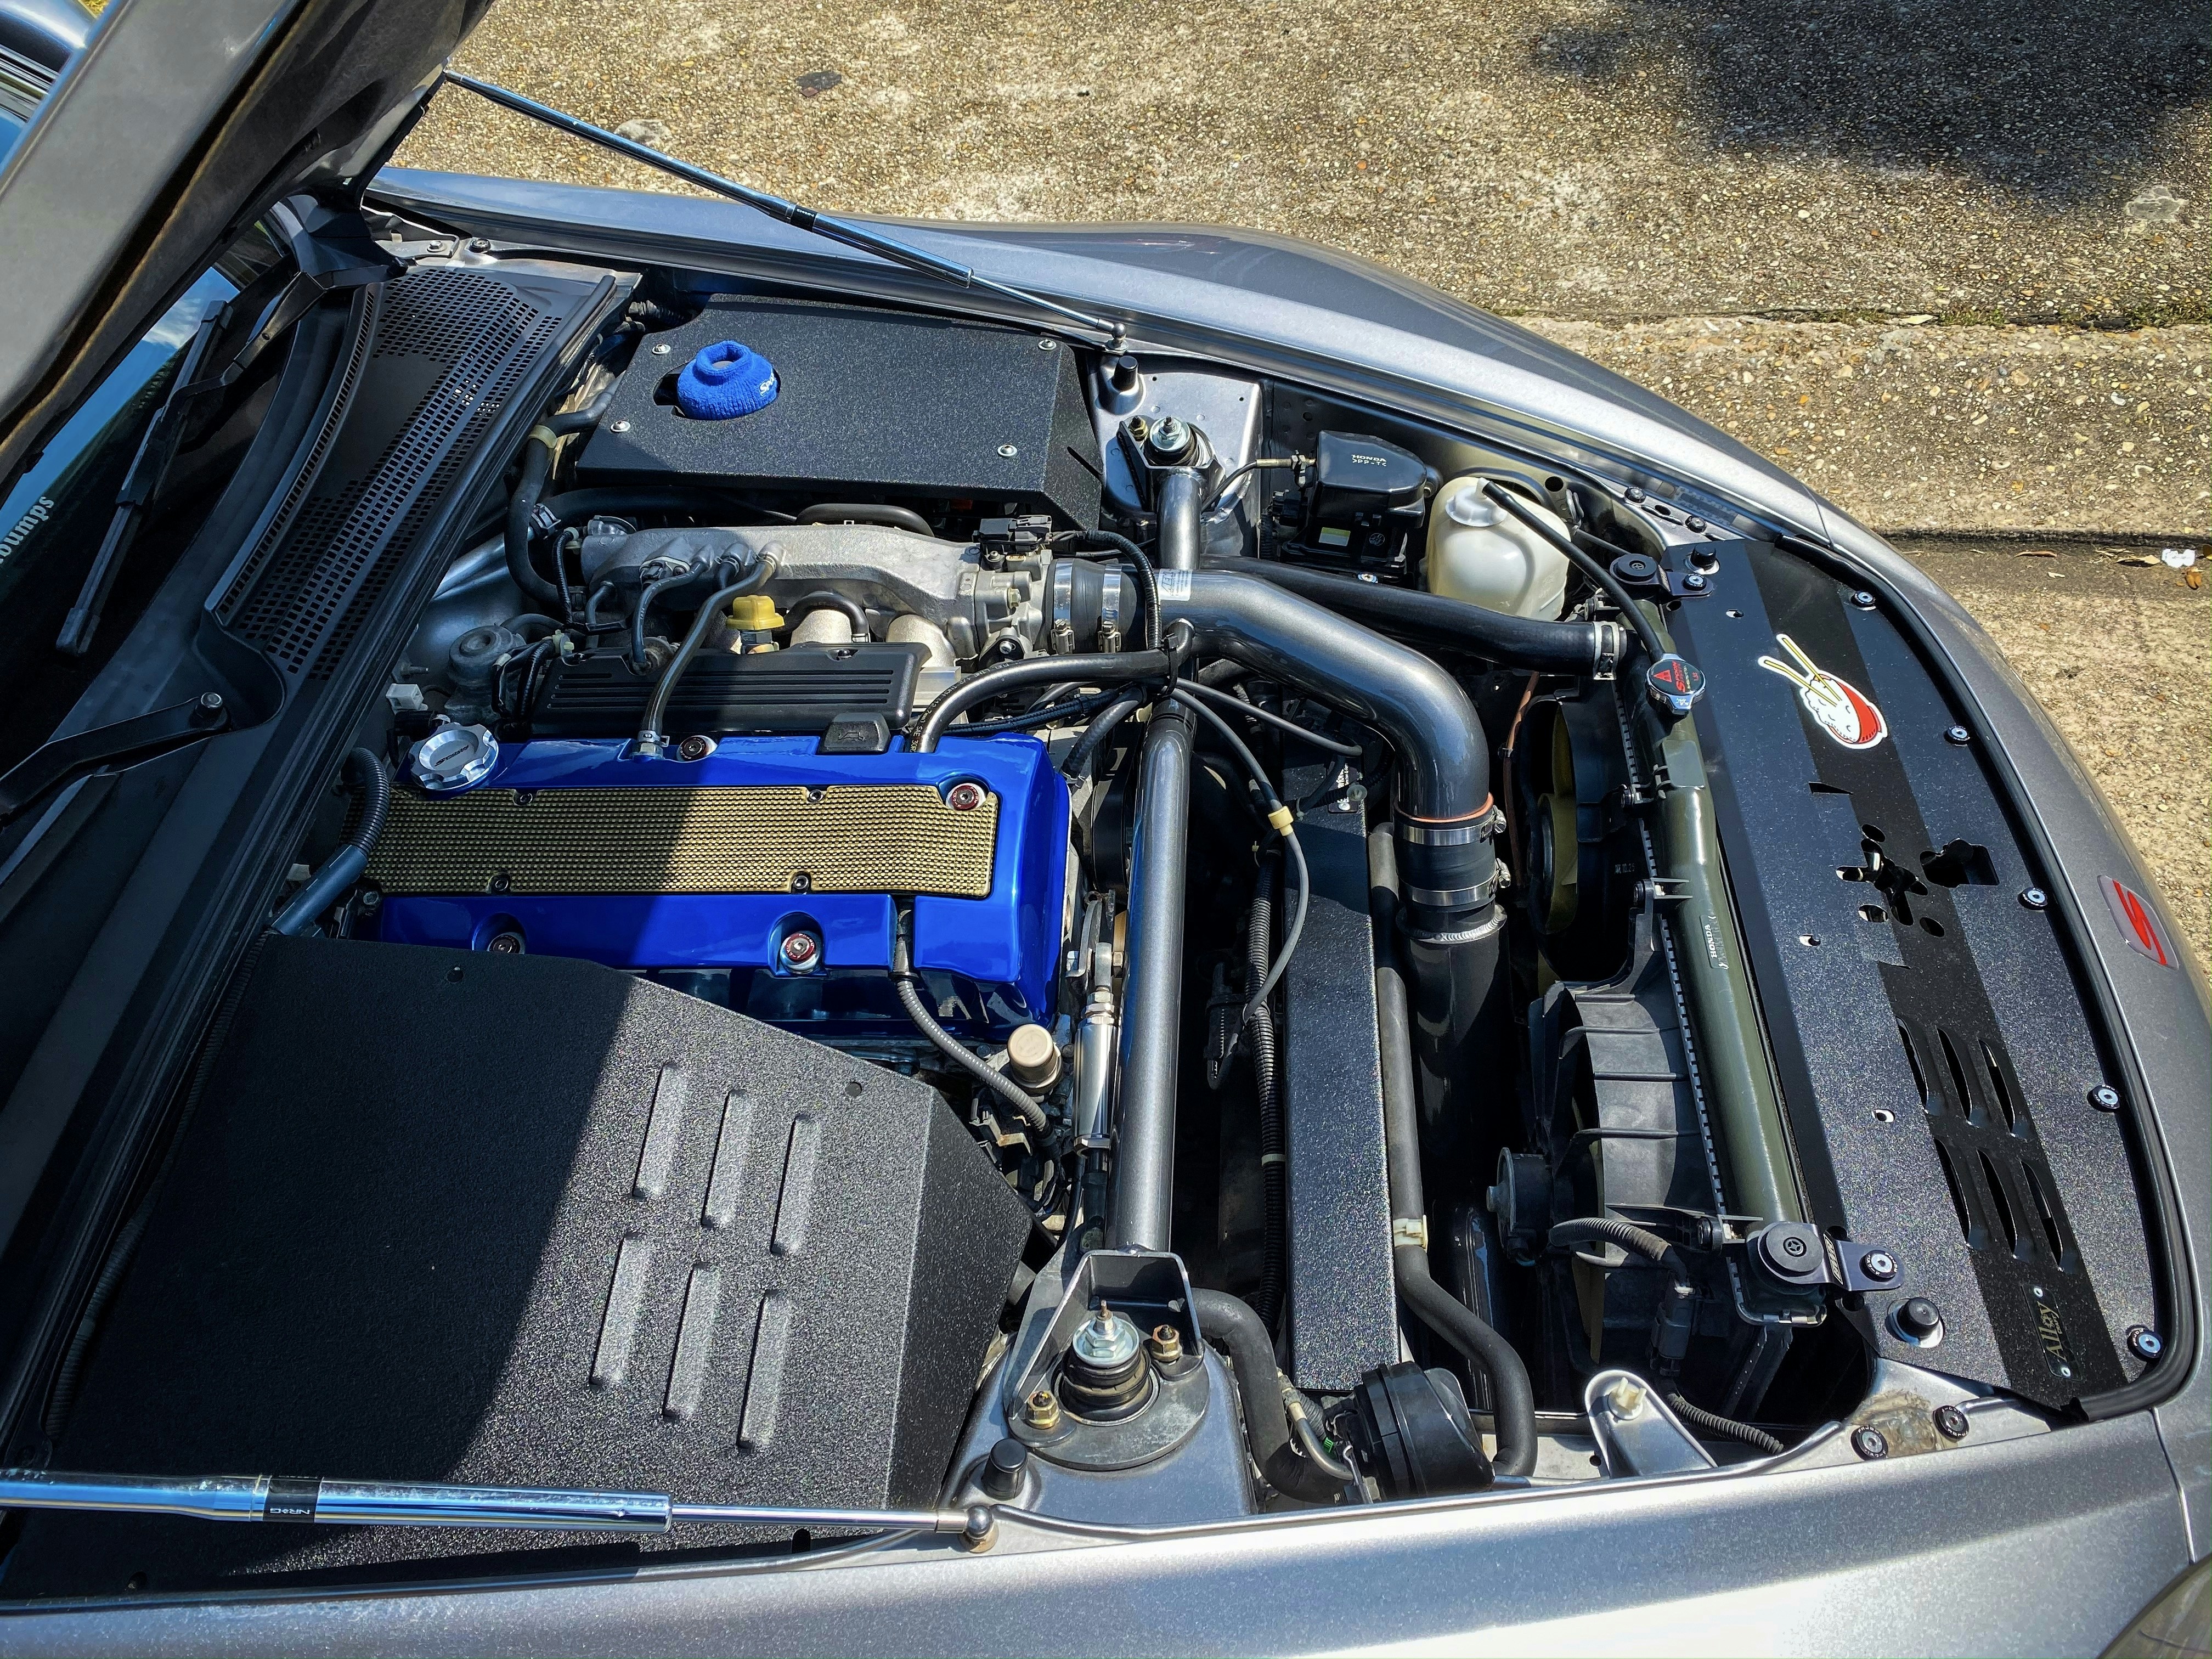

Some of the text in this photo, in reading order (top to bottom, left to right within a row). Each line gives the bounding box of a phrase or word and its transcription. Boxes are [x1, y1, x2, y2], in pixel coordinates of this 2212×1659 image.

[1351, 454, 1387, 462] HONDA
[913, 725, 923, 737] SAE
[910, 740, 918, 753] 30R
[1705, 924, 1718, 959] HONDA
